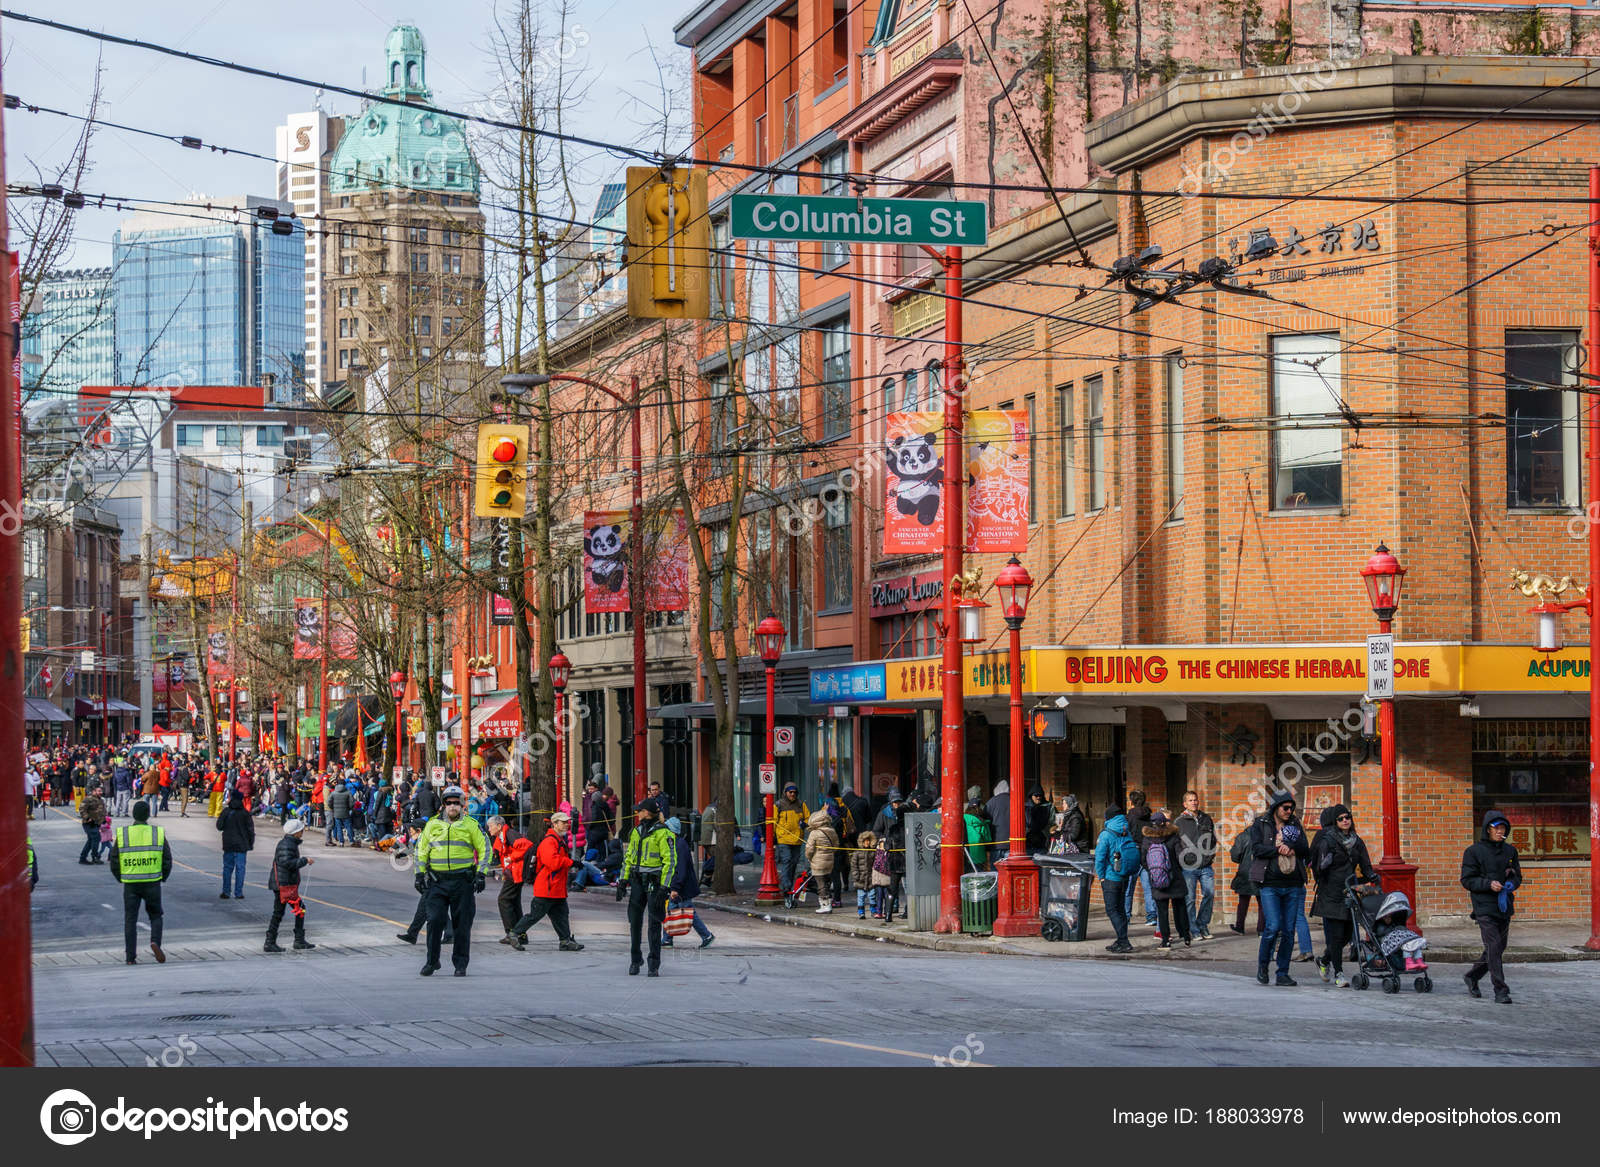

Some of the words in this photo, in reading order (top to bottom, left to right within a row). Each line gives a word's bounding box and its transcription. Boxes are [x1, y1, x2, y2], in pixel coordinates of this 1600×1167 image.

[752, 202, 912, 236] Columbia
[929, 208, 966, 238] St
[1270, 269, 1306, 281] BEIJING
[56, 286, 95, 300] TELUS
[872, 584, 909, 611] Peking
[911, 576, 943, 601] Loun
[1370, 641, 1390, 655] BEGIN
[1065, 656, 1168, 684] BEIJING
[1177, 659, 1211, 679] THE
[1216, 659, 1289, 679] CHINESE
[1295, 659, 1365, 679] HERBAL
[1393, 658, 1430, 678] ORE
[1373, 658, 1388, 672] ONE
[1373, 678, 1388, 691] WAY
[124, 857, 158, 867] SECURITY
